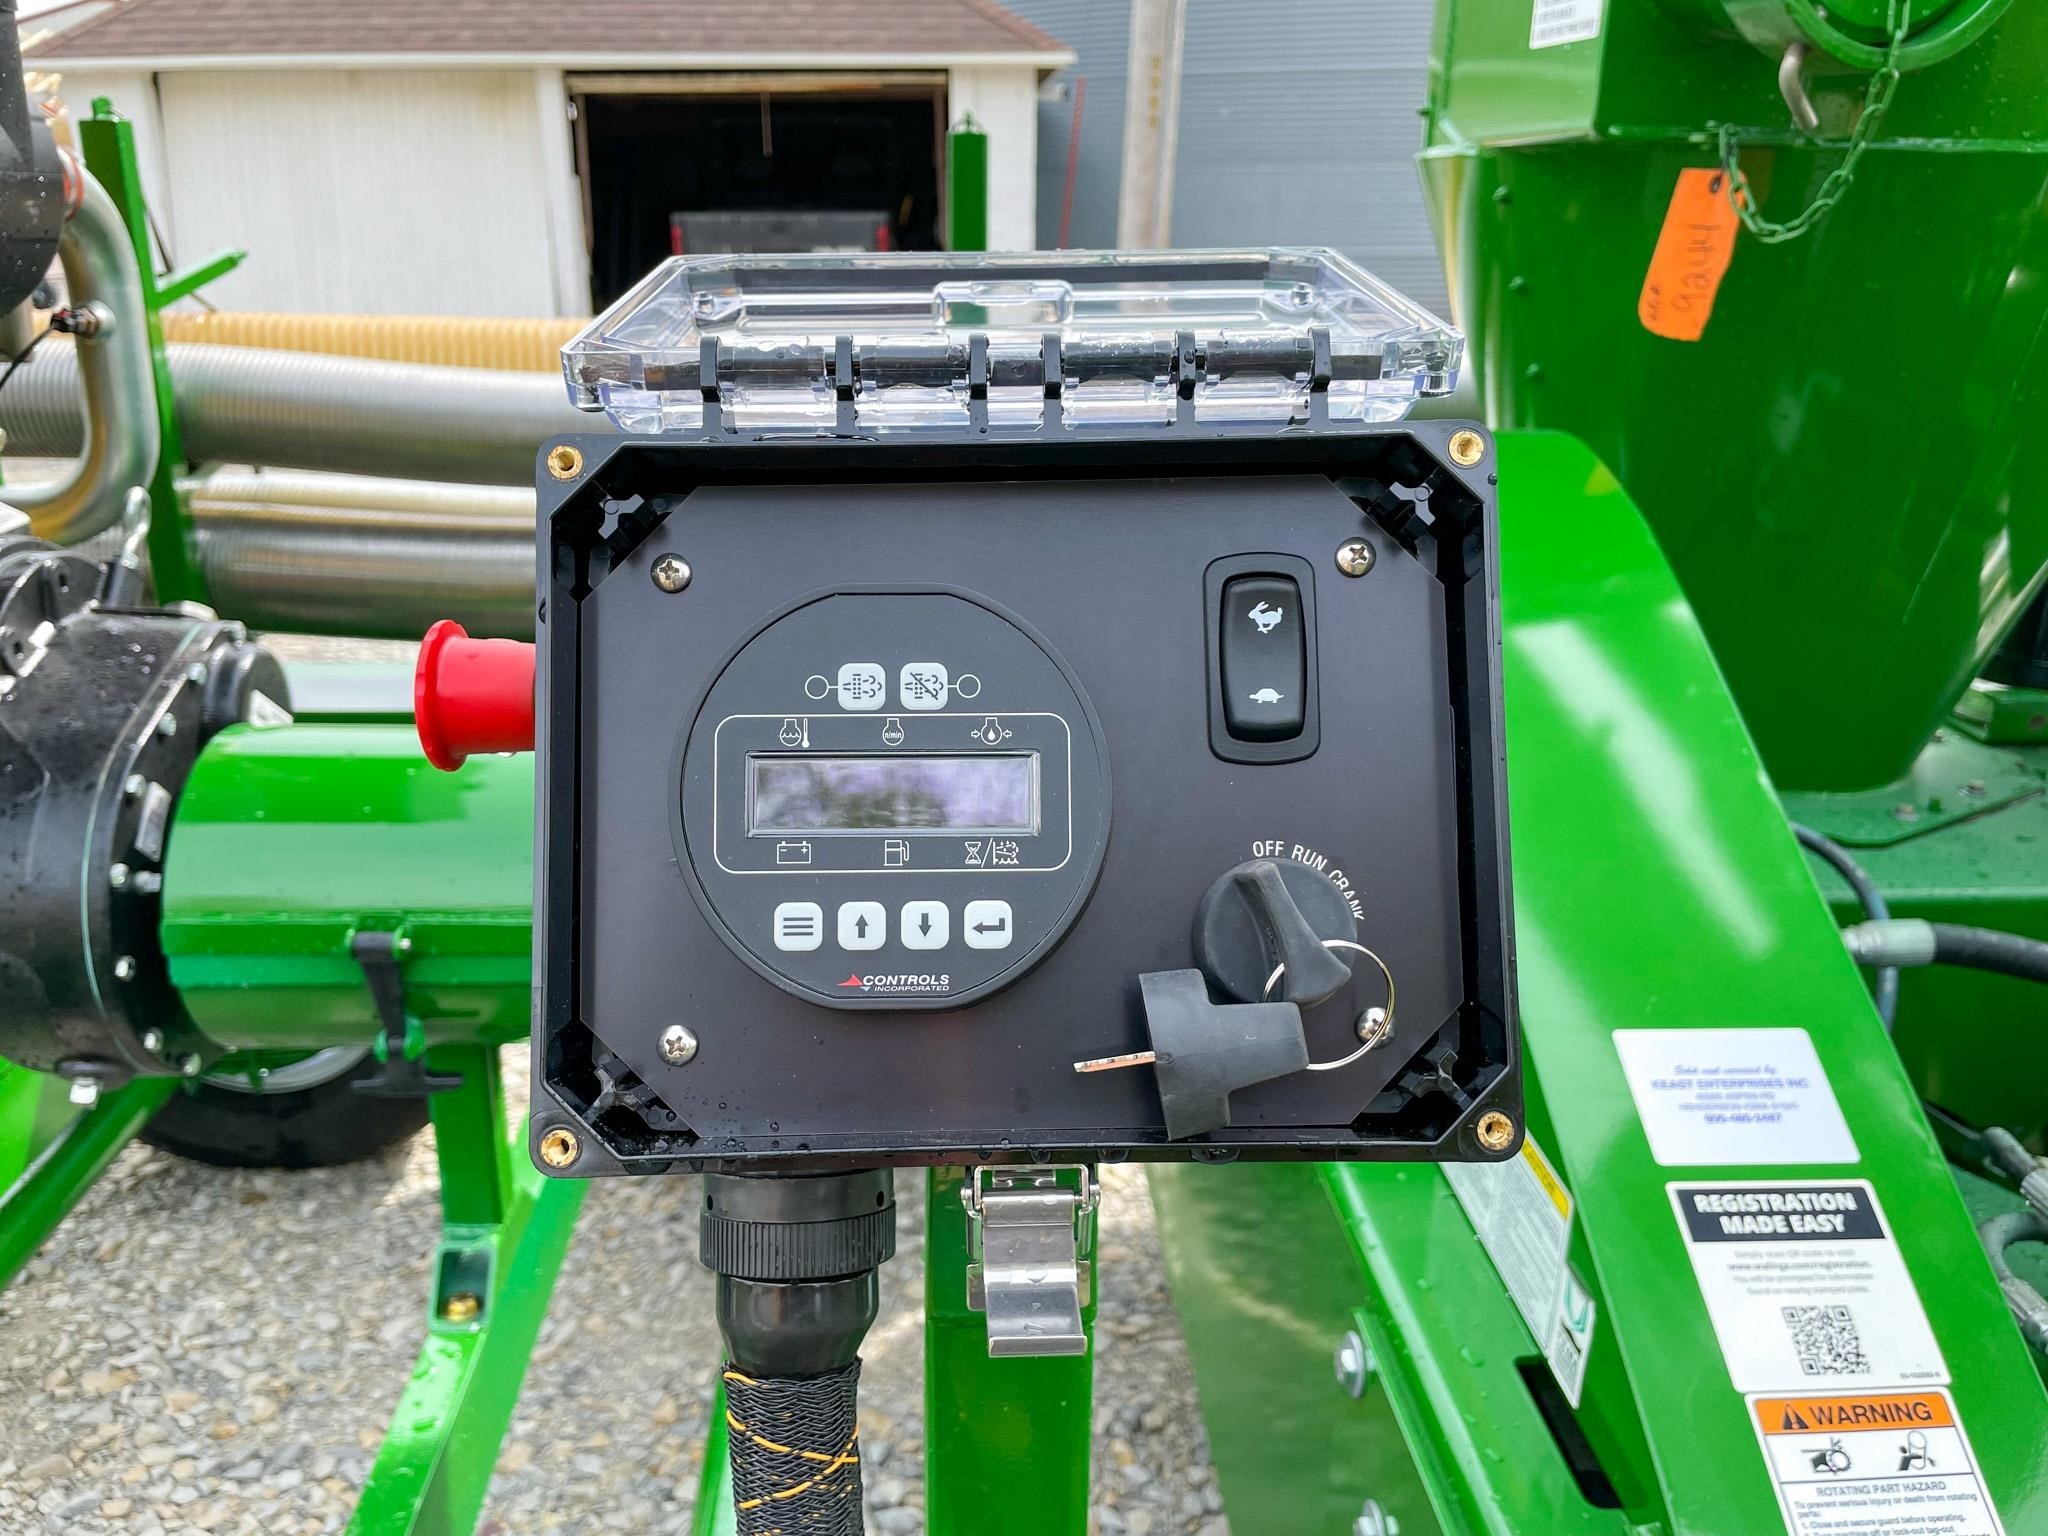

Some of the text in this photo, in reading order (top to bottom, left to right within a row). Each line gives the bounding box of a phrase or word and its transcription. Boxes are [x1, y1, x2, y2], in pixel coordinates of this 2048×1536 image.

[1252, 840, 1365, 921] OFF RUN CRANK
[862, 974, 950, 986] CONTROLS
[1693, 1192, 1858, 1213] REGISTRATION
[1718, 1213, 1846, 1234] MADE EASY
[1808, 1401, 1934, 1425] WARNING
[1816, 1481, 1947, 1497] ROTATING PART HAZARD
